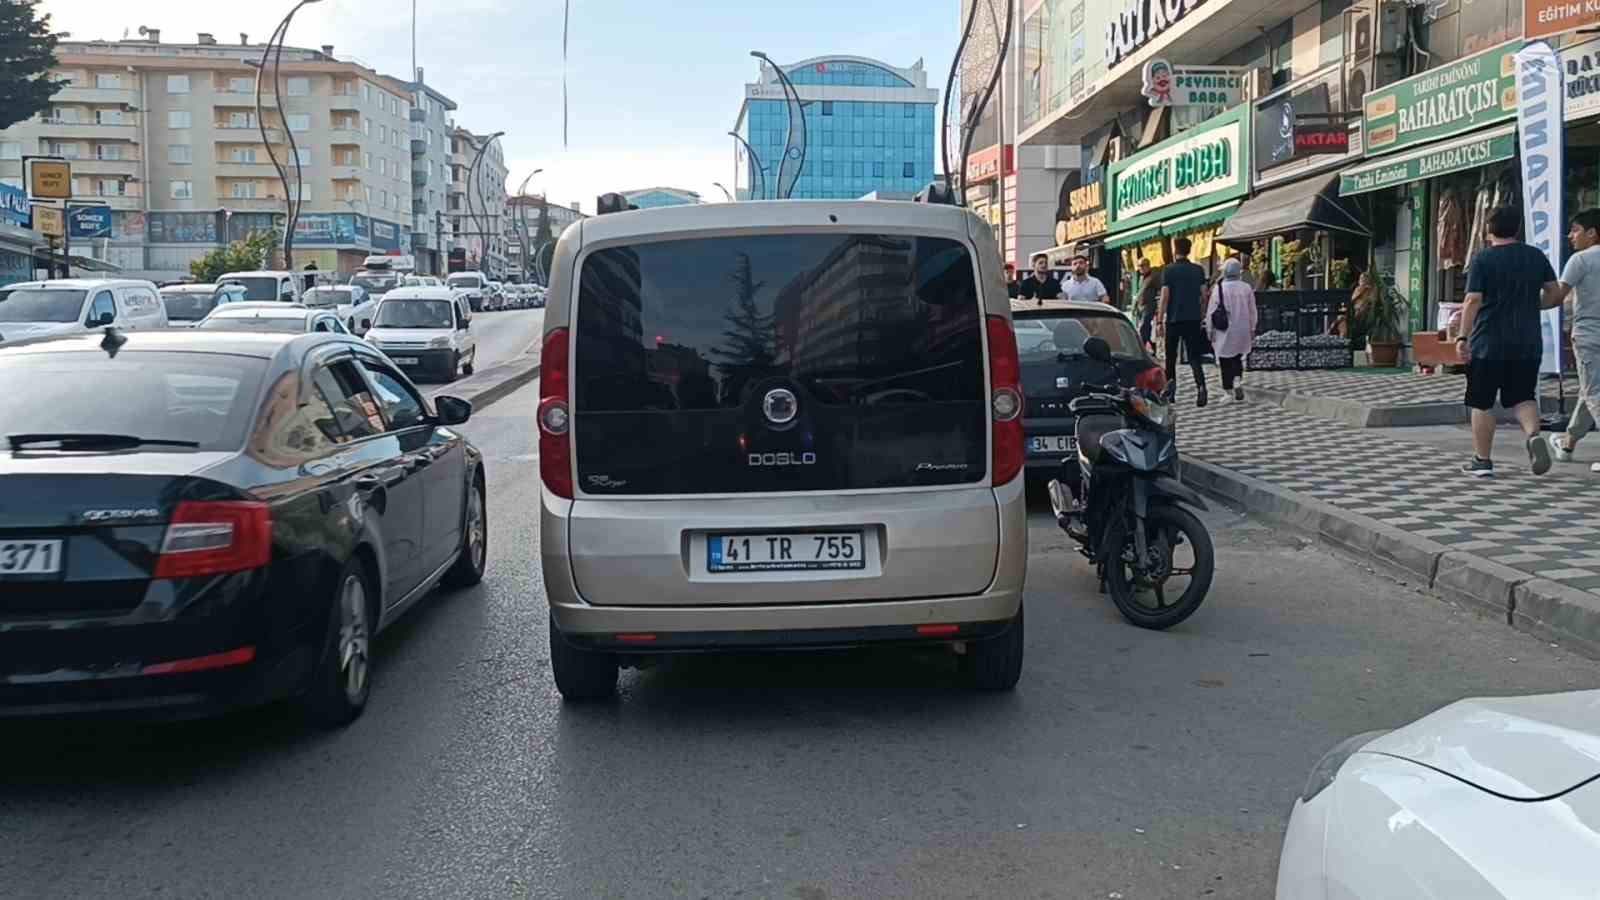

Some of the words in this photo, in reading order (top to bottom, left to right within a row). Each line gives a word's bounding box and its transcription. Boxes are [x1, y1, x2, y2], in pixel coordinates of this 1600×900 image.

[1538, 3, 1581, 22] EĞİTİM
[1188, 91, 1228, 104] BABA
[1398, 79, 1498, 133] BAHARATÇISI
[1175, 137, 1232, 190] BABA
[1420, 141, 1491, 175] BAHARATÇISI
[1034, 438, 1048, 450] 34
[748, 452, 816, 466] DOBLO
[0, 543, 53, 570] 371
[727, 538, 750, 560] 41
[766, 537, 792, 560] TR
[813, 536, 854, 558] 755
